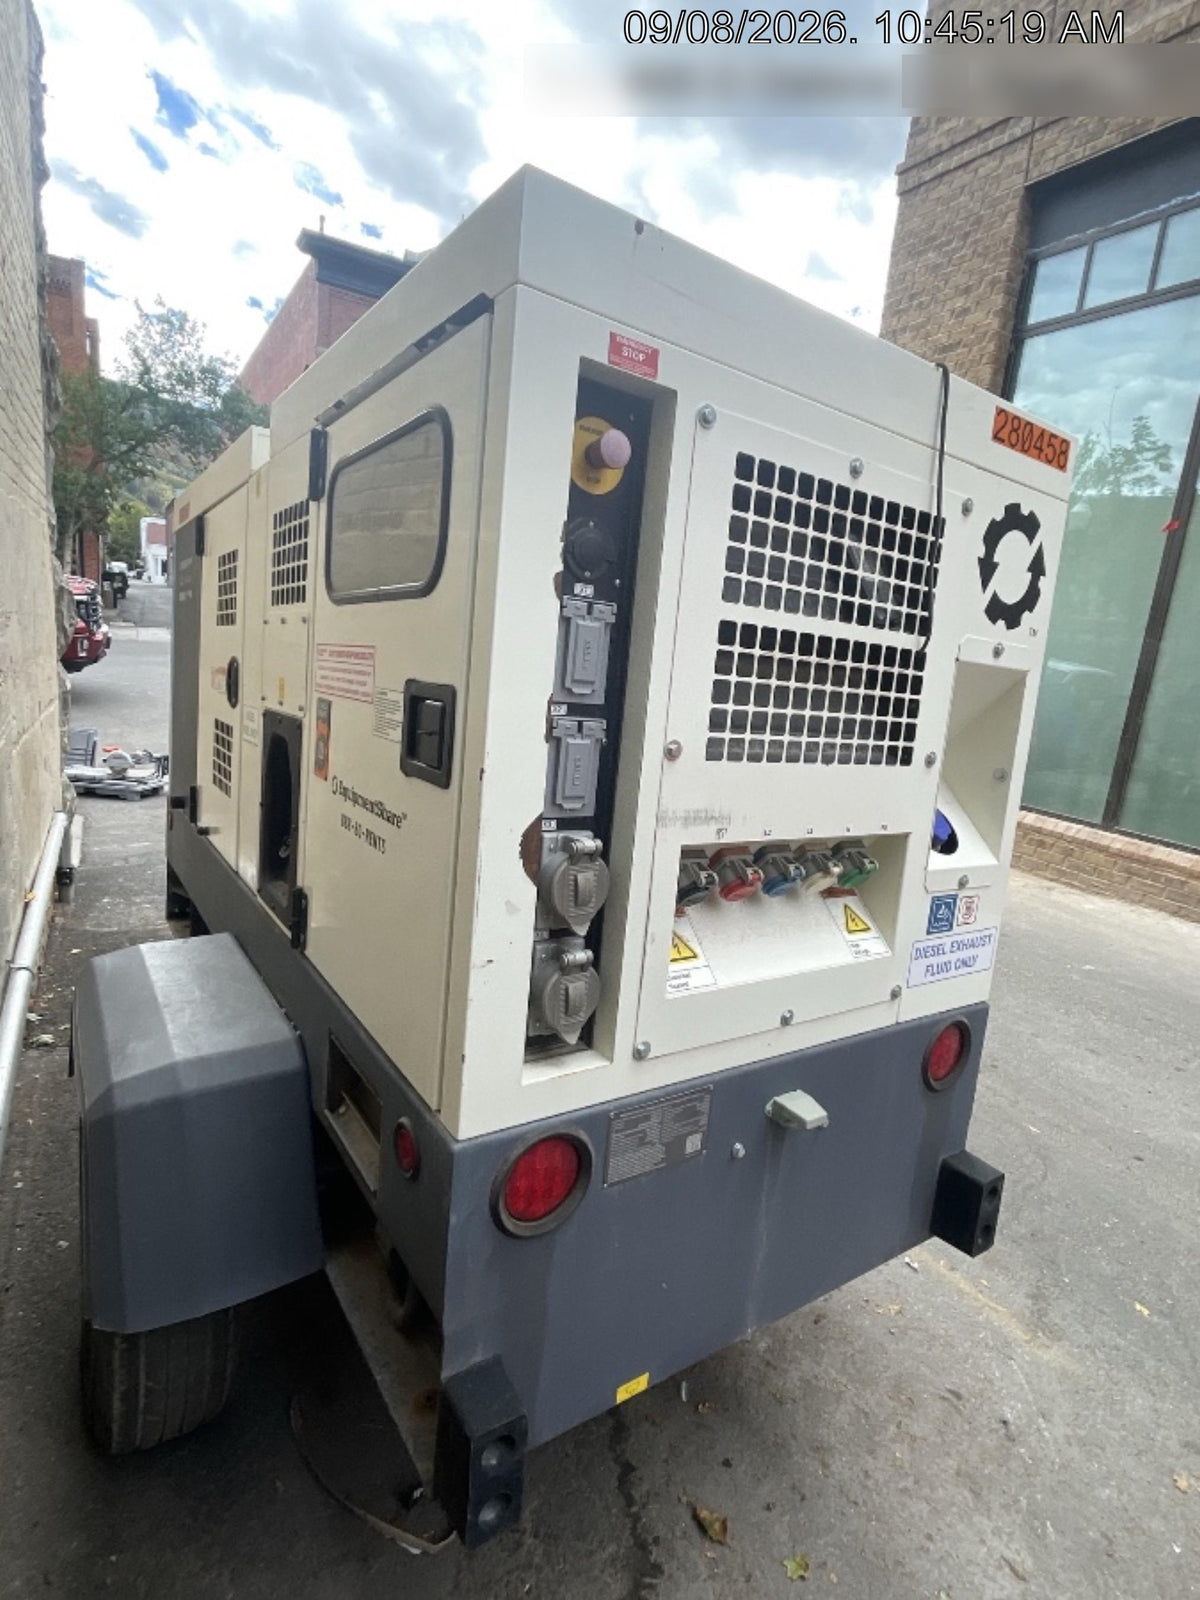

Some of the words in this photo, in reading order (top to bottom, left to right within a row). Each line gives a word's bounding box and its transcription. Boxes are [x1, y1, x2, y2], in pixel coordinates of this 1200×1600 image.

[621, 345, 647, 362] STOP
[992, 409, 1070, 470] 280458
[914, 943, 948, 961] DIESEL
[949, 934, 993, 953] EXHAUST
[924, 959, 952, 978] FLUID
[954, 954, 979, 971] ONLY
